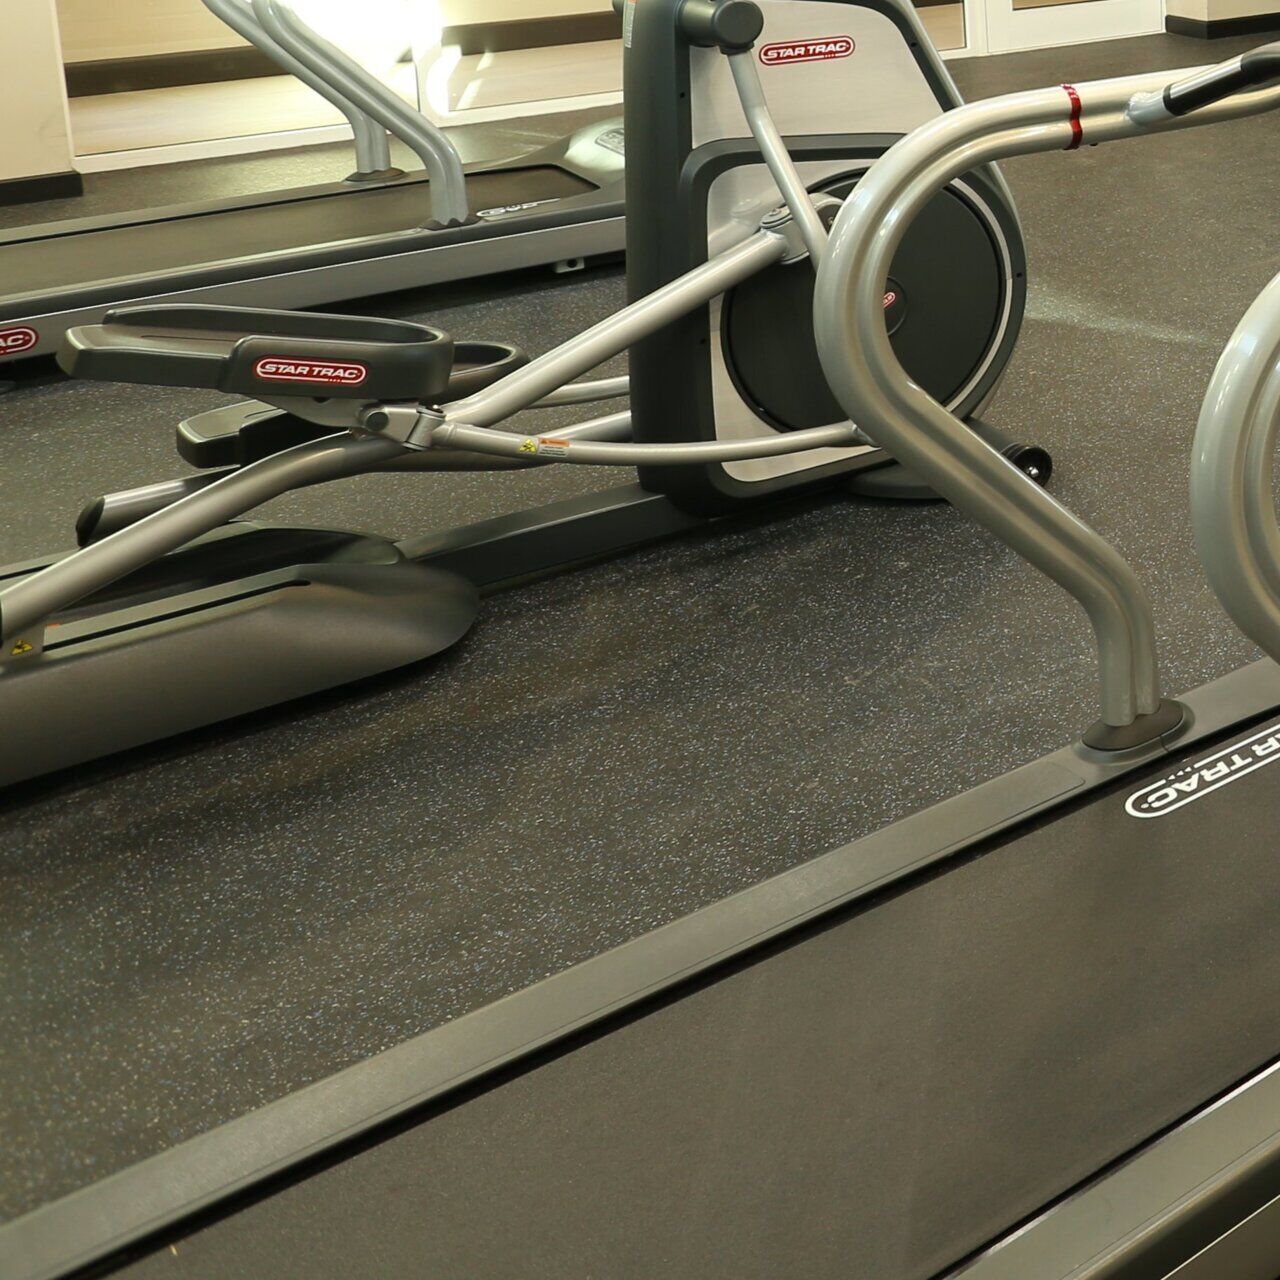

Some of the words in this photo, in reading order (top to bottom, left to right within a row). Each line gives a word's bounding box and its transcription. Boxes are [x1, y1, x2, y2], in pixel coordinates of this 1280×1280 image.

[766, 47, 806, 59] STAR
[806, 42, 847, 54] TRAC
[264, 364, 310, 375] STAR
[311, 367, 359, 378] TRAC
[1146, 754, 1253, 808] TRAC
